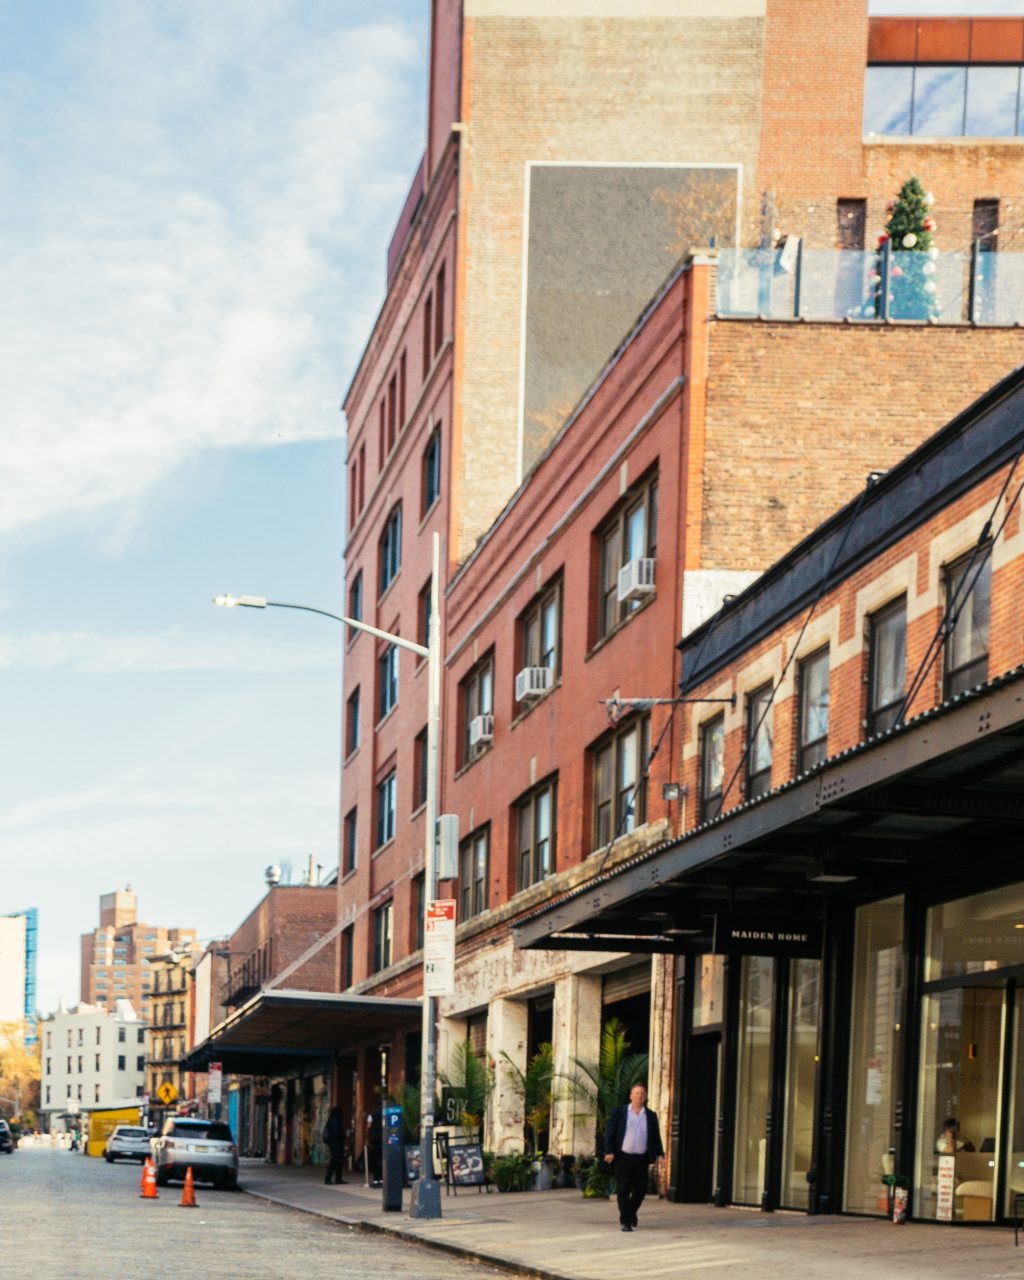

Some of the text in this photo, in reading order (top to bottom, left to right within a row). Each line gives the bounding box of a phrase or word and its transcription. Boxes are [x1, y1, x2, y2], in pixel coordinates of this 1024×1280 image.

[731, 930, 808, 941] MAIDEN HOME
[391, 1115, 398, 1125] P
